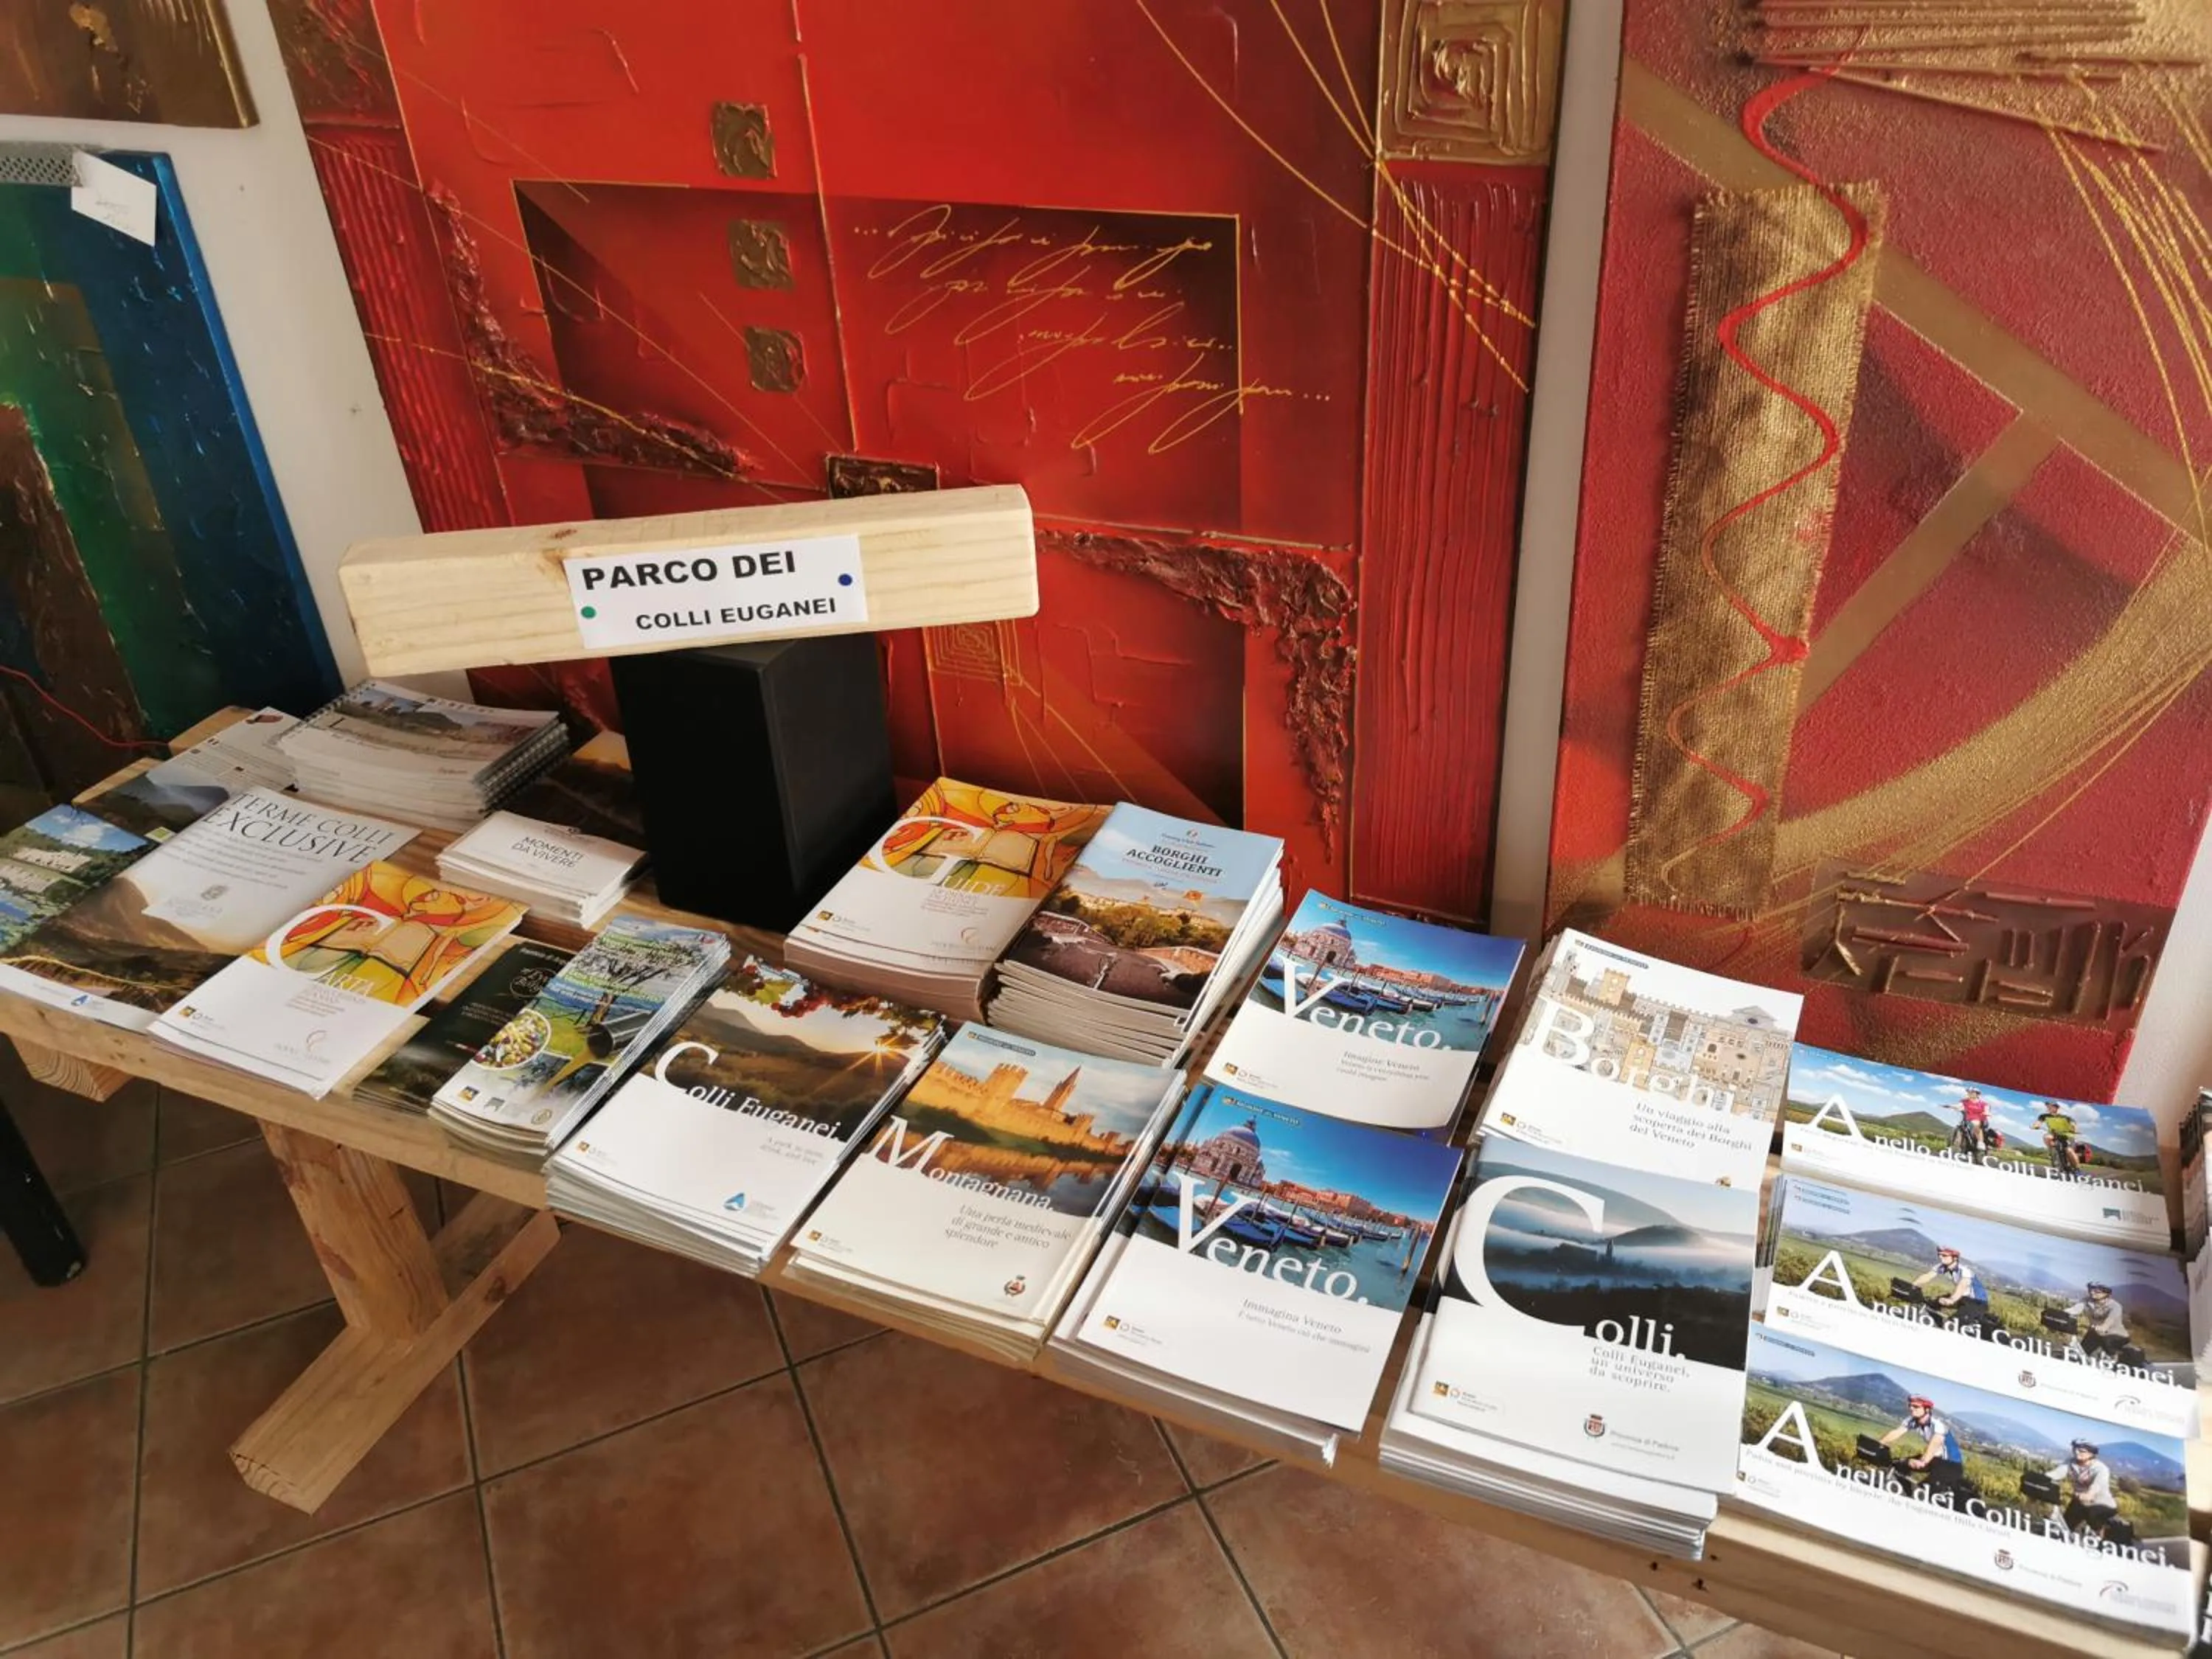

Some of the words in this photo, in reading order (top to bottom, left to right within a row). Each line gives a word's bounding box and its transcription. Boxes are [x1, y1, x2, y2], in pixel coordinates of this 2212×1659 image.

[582, 558, 718, 591] PARCO
[732, 551, 796, 579] DEI
[636, 609, 712, 630] COLLI
[720, 597, 837, 624] EUGANEI
[202, 807, 375, 863] EXCLUSIVE
[229, 793, 315, 827] TERME
[317, 818, 395, 845] COLLI
[511, 842, 530, 854] DA
[531, 846, 577, 869] VIVERE
[522, 836, 585, 860] MOMENTI
[1126, 849, 1223, 877] ACCOGLIENTI
[1151, 844, 1209, 864] BORGHI
[265, 903, 398, 997] CARTA
[654, 1041, 735, 1112] Colli
[1633, 1113, 1684, 1134] scoperta
[1686, 1128, 1706, 1139] dei
[1708, 1133, 1752, 1151] Borghi
[1636, 1102, 1654, 1114] Un
[1658, 1110, 1704, 1128] viaggio
[1706, 1122, 1731, 1135] alla
[1629, 1124, 1649, 1135] del
[1652, 1128, 1696, 1149] Veneto
[1802, 1093, 1933, 1160] Anello
[1938, 1143, 1974, 1166] dei
[1982, 1153, 2037, 1180] Colli
[945, 1228, 998, 1249] splendore
[950, 1216, 964, 1226] di
[964, 1221, 1004, 1238] grande
[1005, 1232, 1013, 1240] e
[1013, 1233, 1051, 1249] antico
[959, 1204, 981, 1219] Una
[981, 1212, 1012, 1228] perla
[1013, 1221, 1072, 1240] medievale
[1242, 1297, 1300, 1324] Immagina
[1303, 1315, 1343, 1335] Veneto
[1795, 1248, 1935, 1329] Anello
[1943, 1315, 1983, 1343] dei
[1992, 1327, 2053, 1361] Colli
[1591, 1356, 1608, 1368] un
[1615, 1363, 1674, 1384] universo
[1593, 1346, 1624, 1361] Colli
[1630, 1354, 1691, 1378] Euganei,
[1589, 1366, 1606, 1377] da
[1611, 1371, 1671, 1393] scoprire.
[1755, 1400, 1904, 1498] Anello
[1912, 1481, 1955, 1511] dei
[1964, 1495, 2031, 1534] Colli
